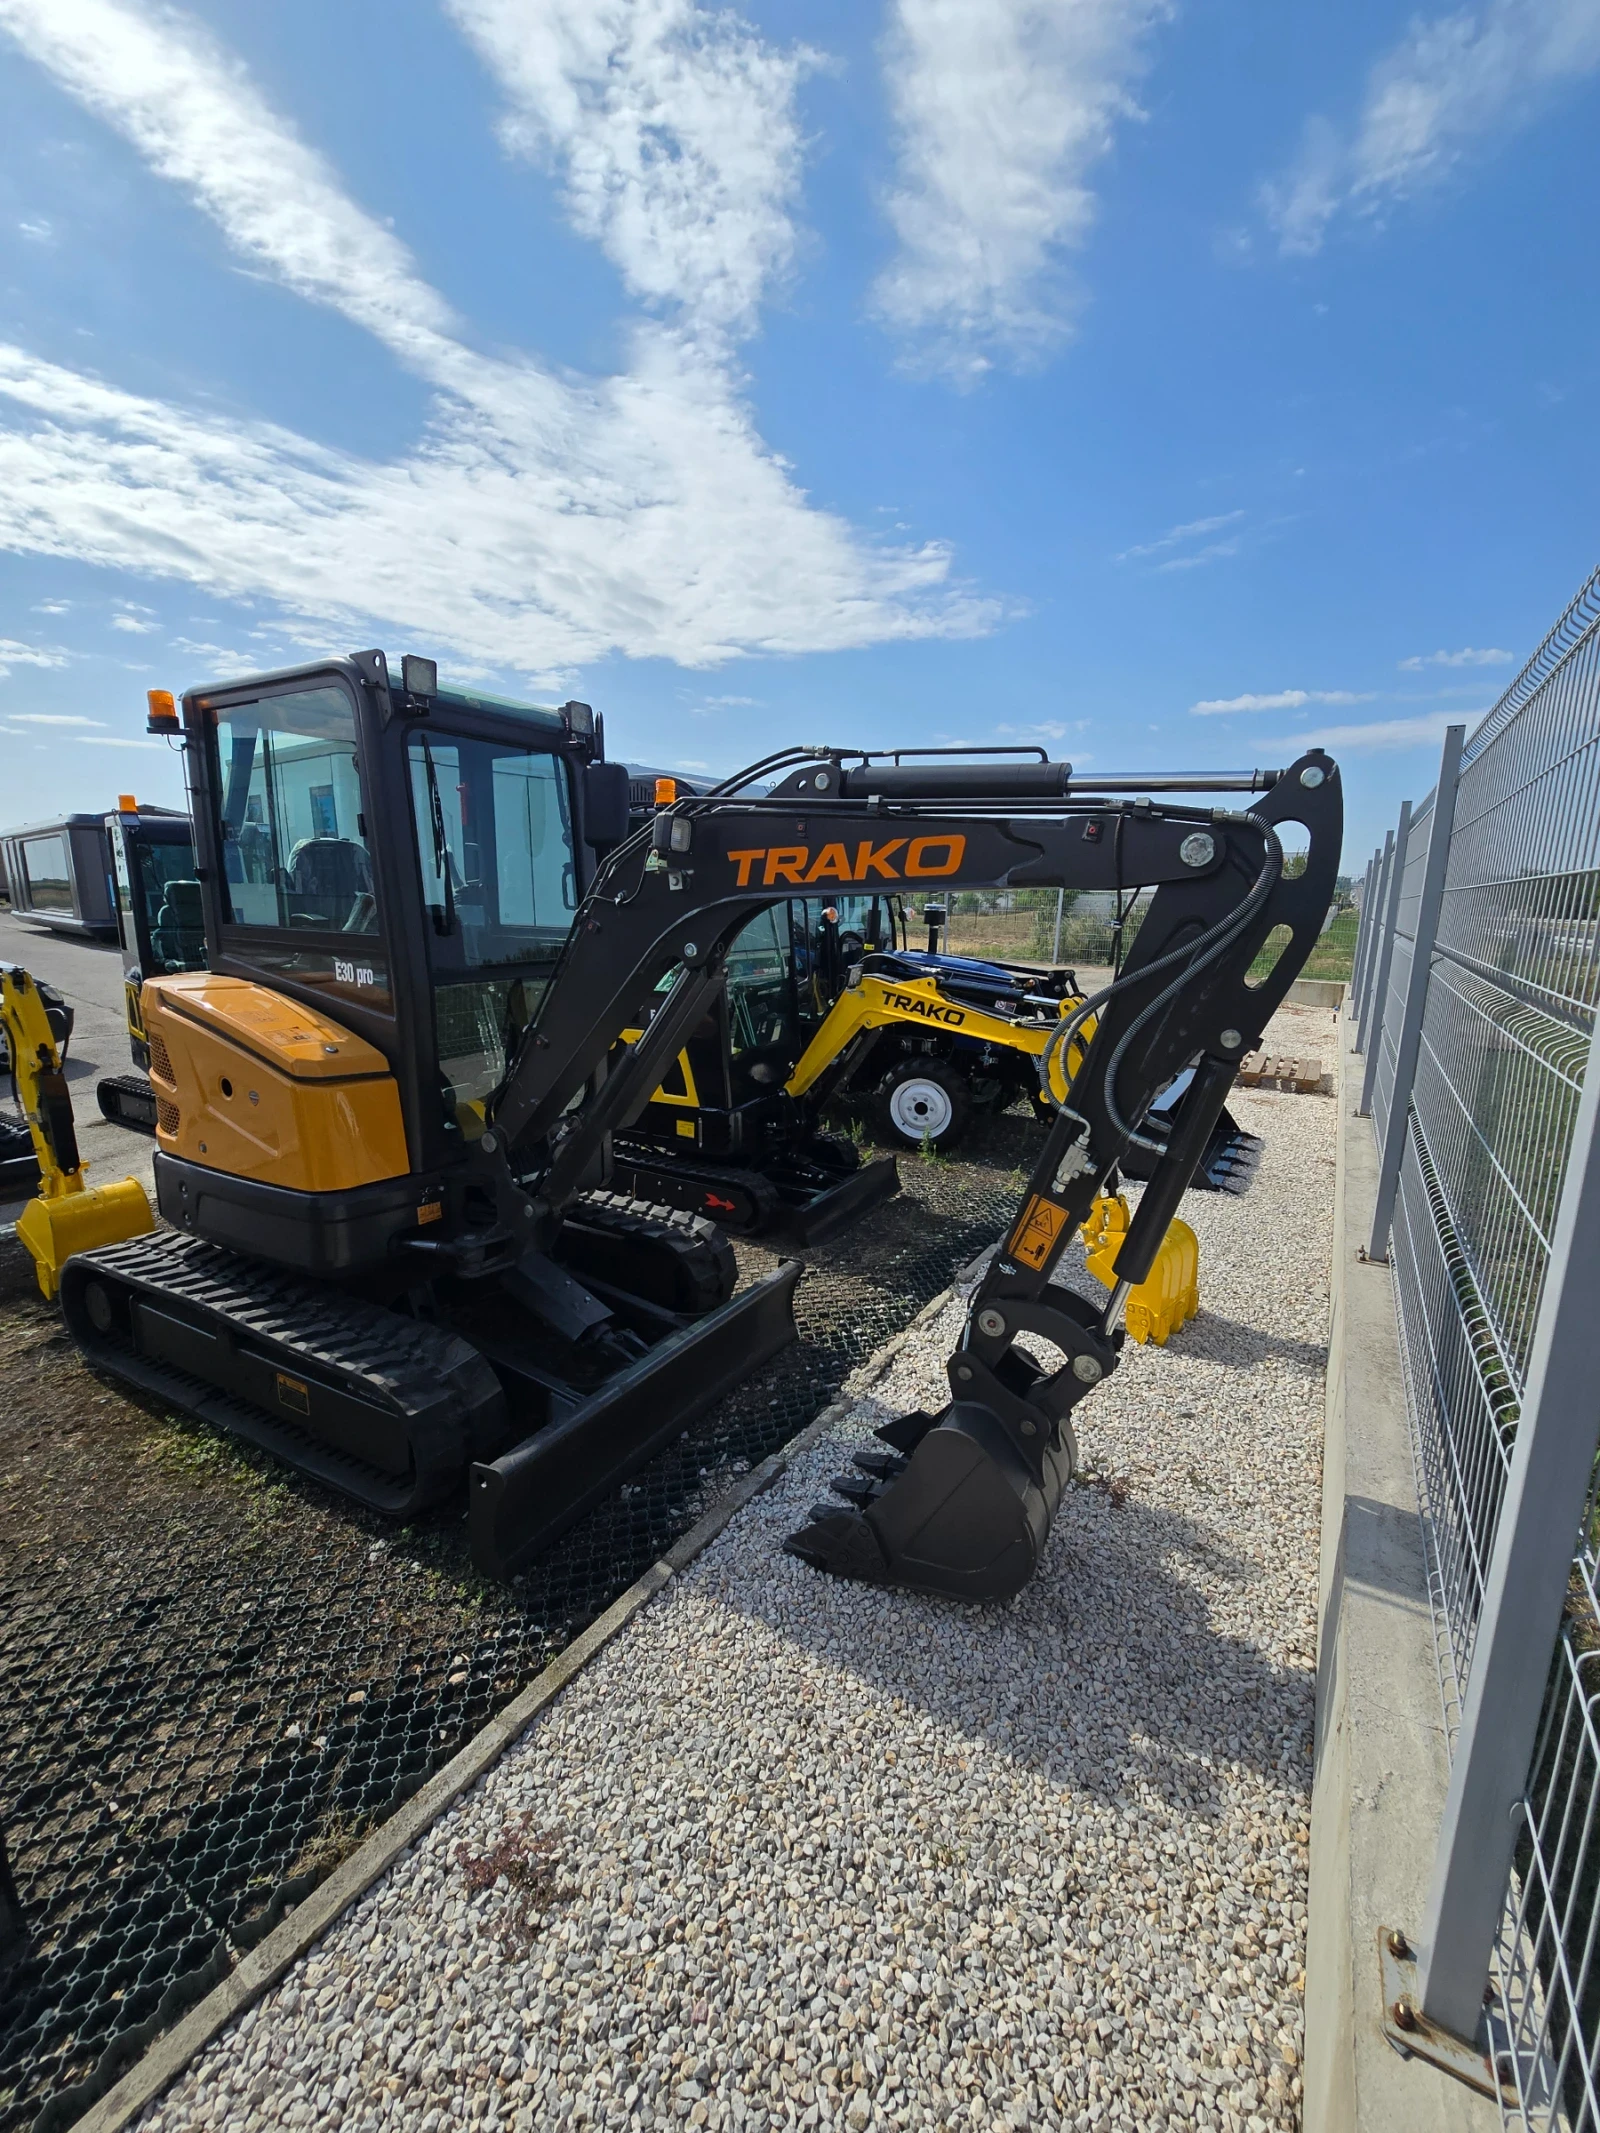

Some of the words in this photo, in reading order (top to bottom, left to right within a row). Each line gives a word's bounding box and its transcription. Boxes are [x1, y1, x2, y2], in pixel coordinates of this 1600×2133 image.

[727, 834, 966, 887] TRAKO
[335, 961, 355, 983] E30
[356, 968, 374, 988] pro
[882, 990, 965, 1026] TRAKO
